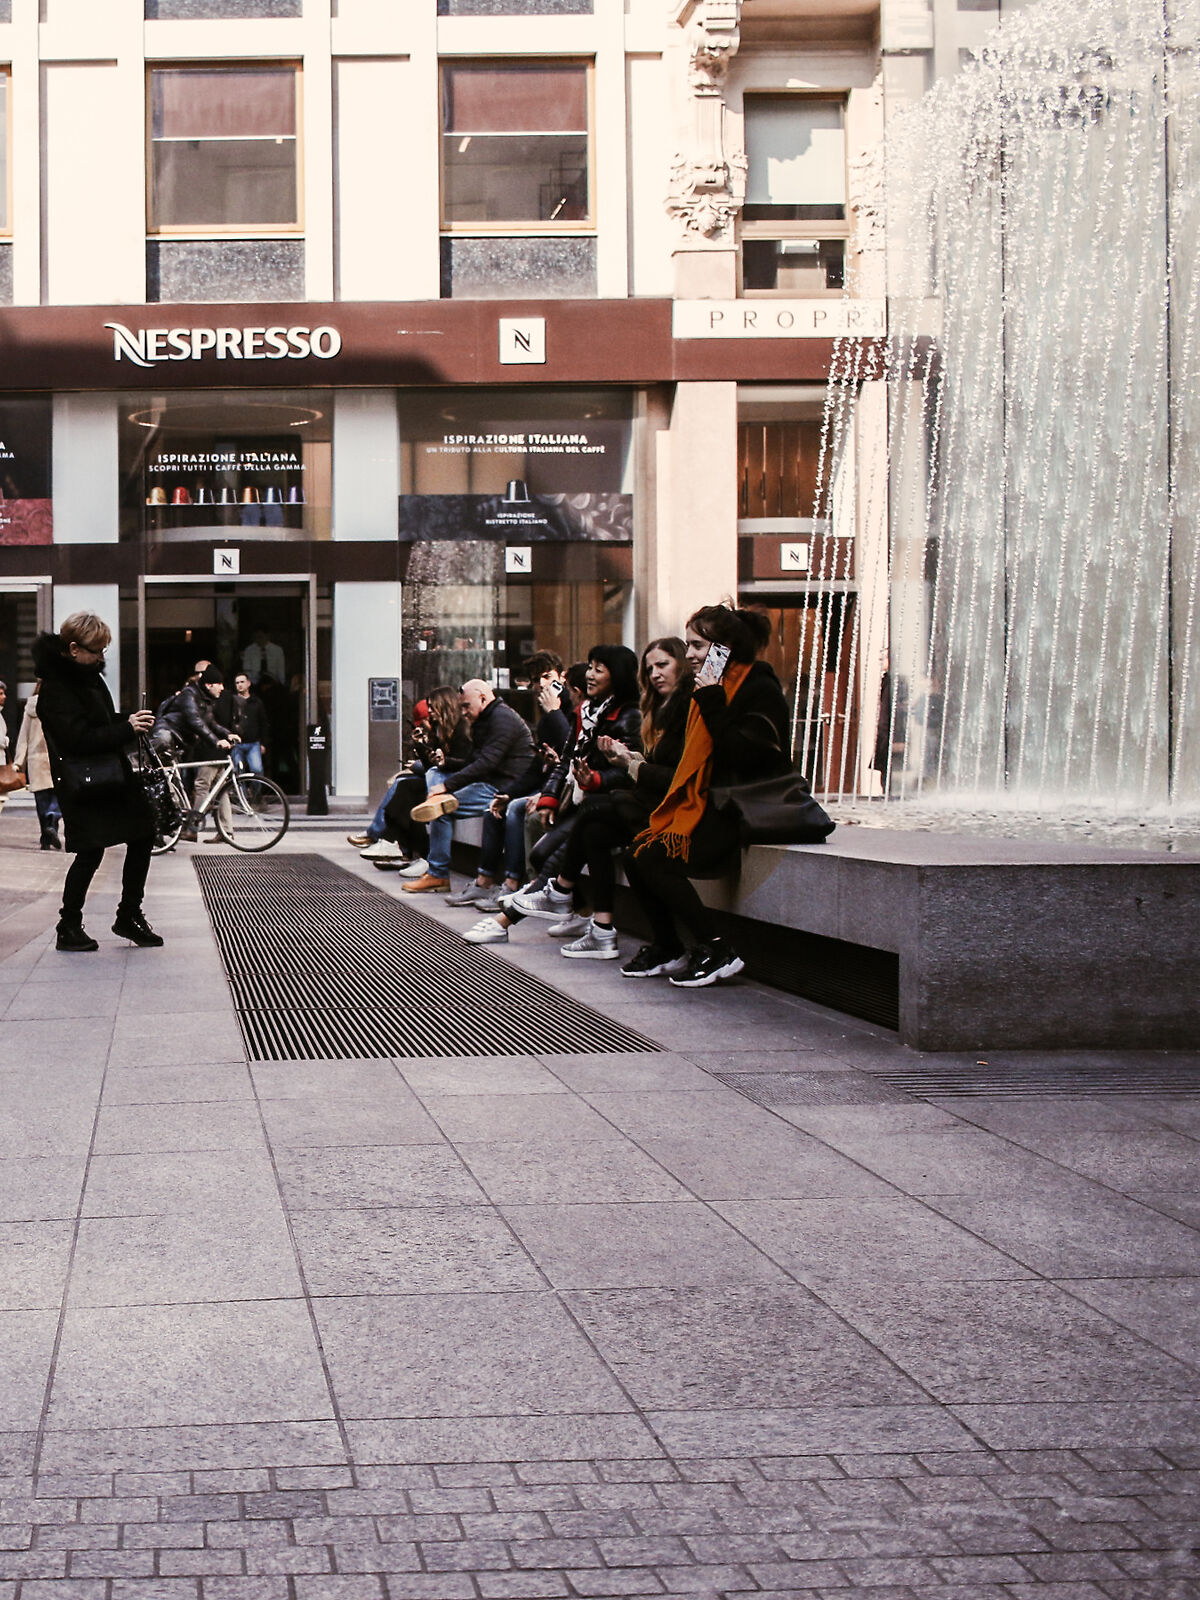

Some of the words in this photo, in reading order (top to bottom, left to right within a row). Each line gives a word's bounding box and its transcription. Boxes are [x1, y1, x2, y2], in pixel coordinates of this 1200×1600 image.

[103, 322, 342, 367] NESPRESSO
[443, 435, 525, 444] ISPIRAZIONE
[528, 434, 588, 444] ITALIANA
[582, 445, 605, 454] CAFFÈ
[157, 453, 236, 463] ISPIRAZIONE
[240, 453, 297, 462] ITALIANA
[148, 464, 180, 472] SCOPRI
[215, 463, 241, 471] CAFFÈ
